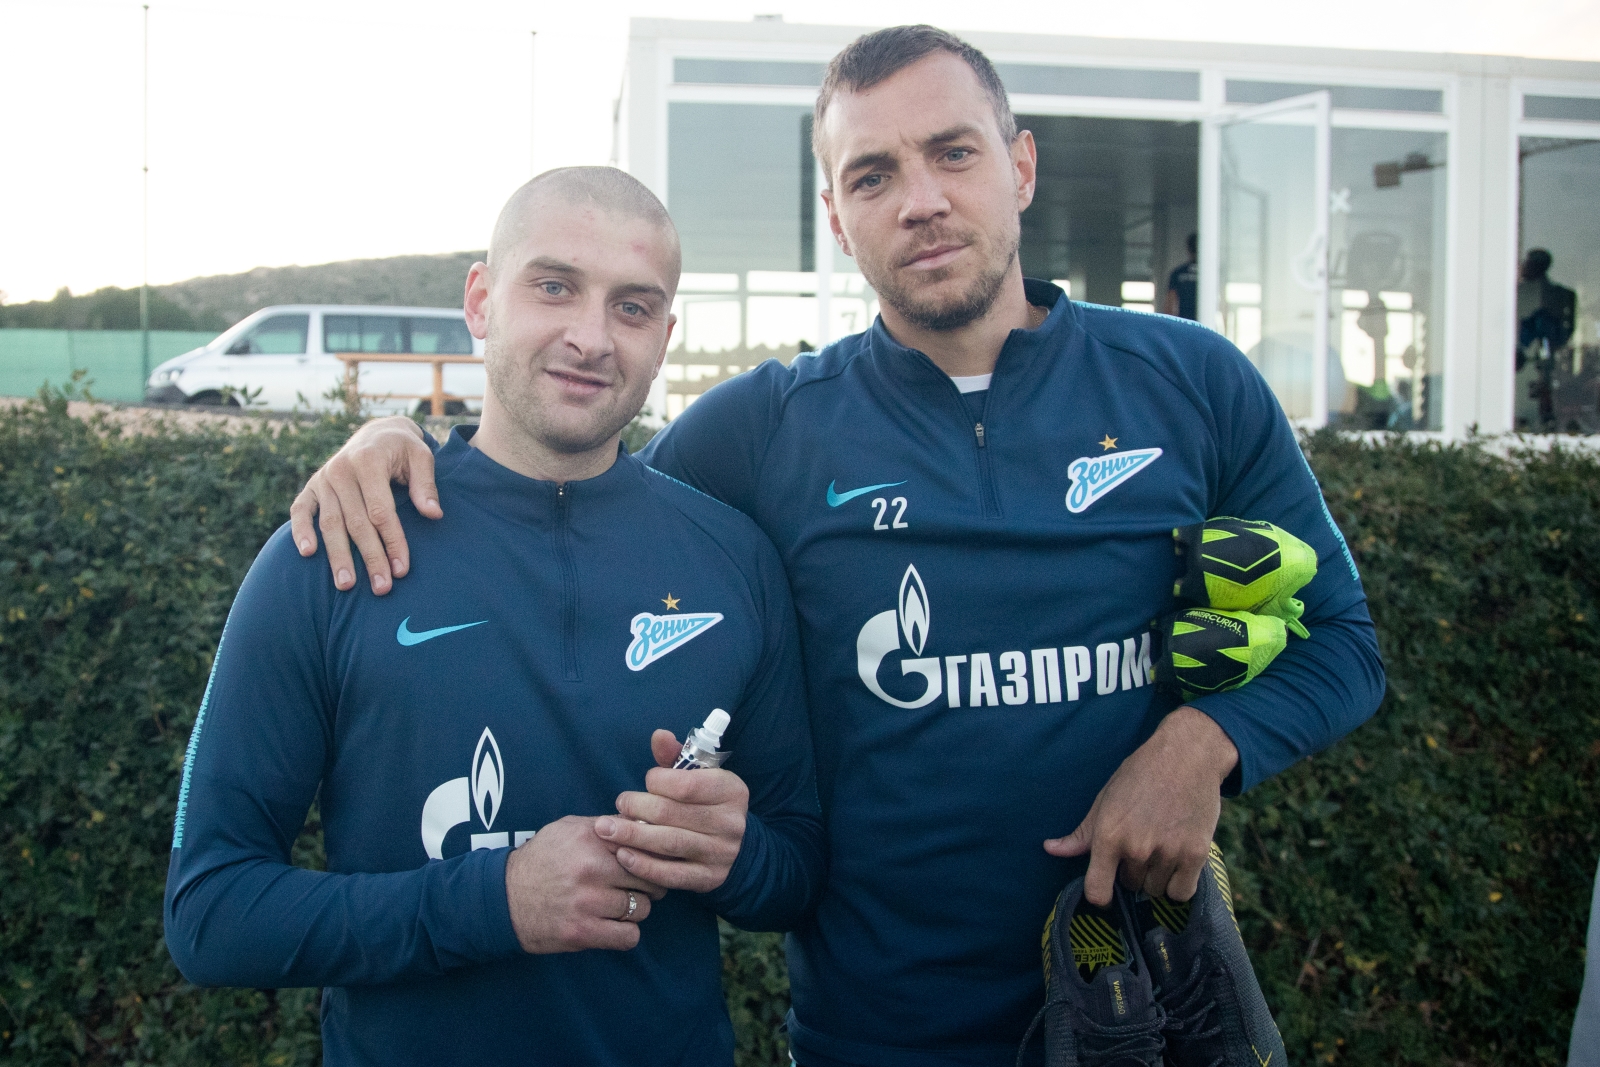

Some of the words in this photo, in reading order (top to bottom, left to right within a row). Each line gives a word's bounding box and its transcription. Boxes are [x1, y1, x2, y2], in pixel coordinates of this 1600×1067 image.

[871, 496, 909, 531] 22
[1185, 610, 1243, 634] MERCURIAL
[945, 632, 1153, 708] ГАЗПРОМ
